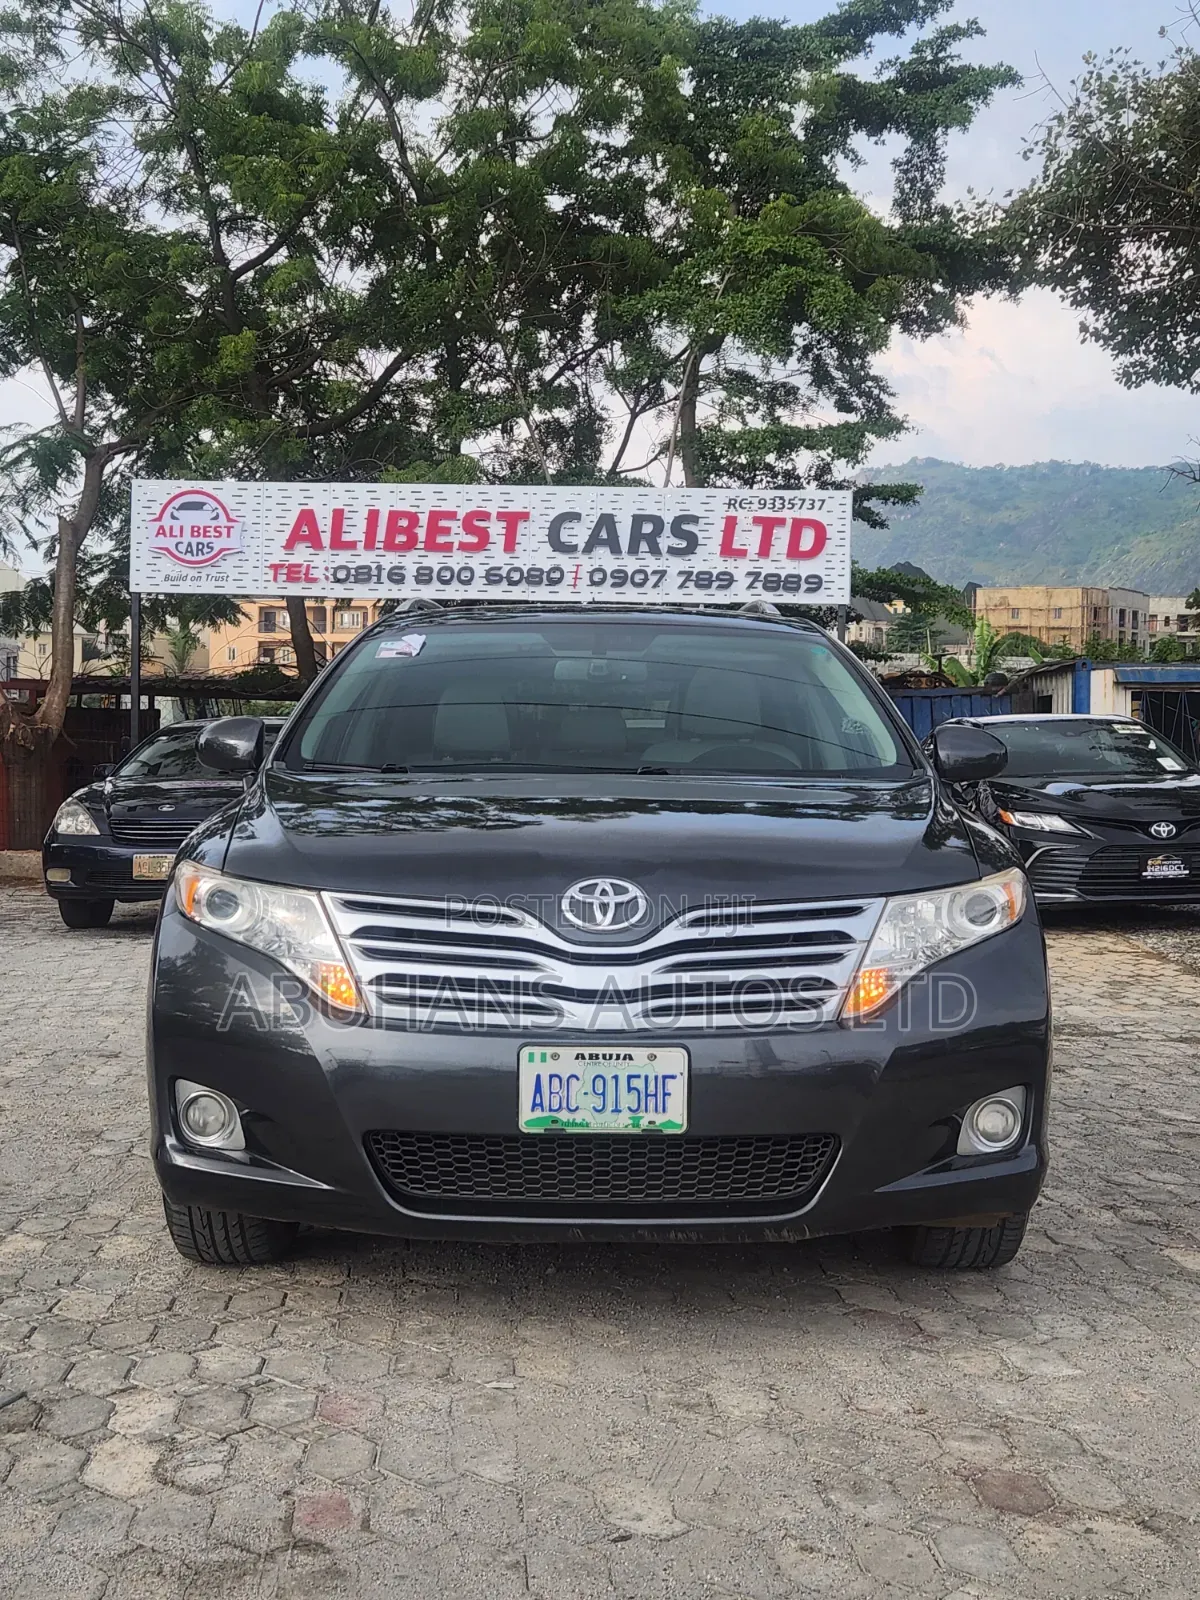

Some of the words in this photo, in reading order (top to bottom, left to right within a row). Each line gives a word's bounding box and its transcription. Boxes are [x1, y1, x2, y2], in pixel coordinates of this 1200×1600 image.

[757, 497, 826, 511] 9335737
[155, 525, 184, 538] ALI
[190, 525, 235, 538] BEST
[283, 507, 531, 554] ALIBEST
[548, 510, 700, 557] CARS
[719, 515, 828, 561] LTD
[175, 541, 214, 557] CARS
[163, 574, 188, 582] Build
[205, 574, 230, 582] Trust
[333, 564, 406, 584] 0816
[415, 566, 475, 585] 800
[485, 566, 565, 586] 6080
[589, 567, 668, 589] 0907
[677, 570, 735, 590] 789
[745, 571, 823, 593] 7889
[574, 1053, 634, 1061] ABUJA
[531, 1073, 677, 1113] ABC-915HF
